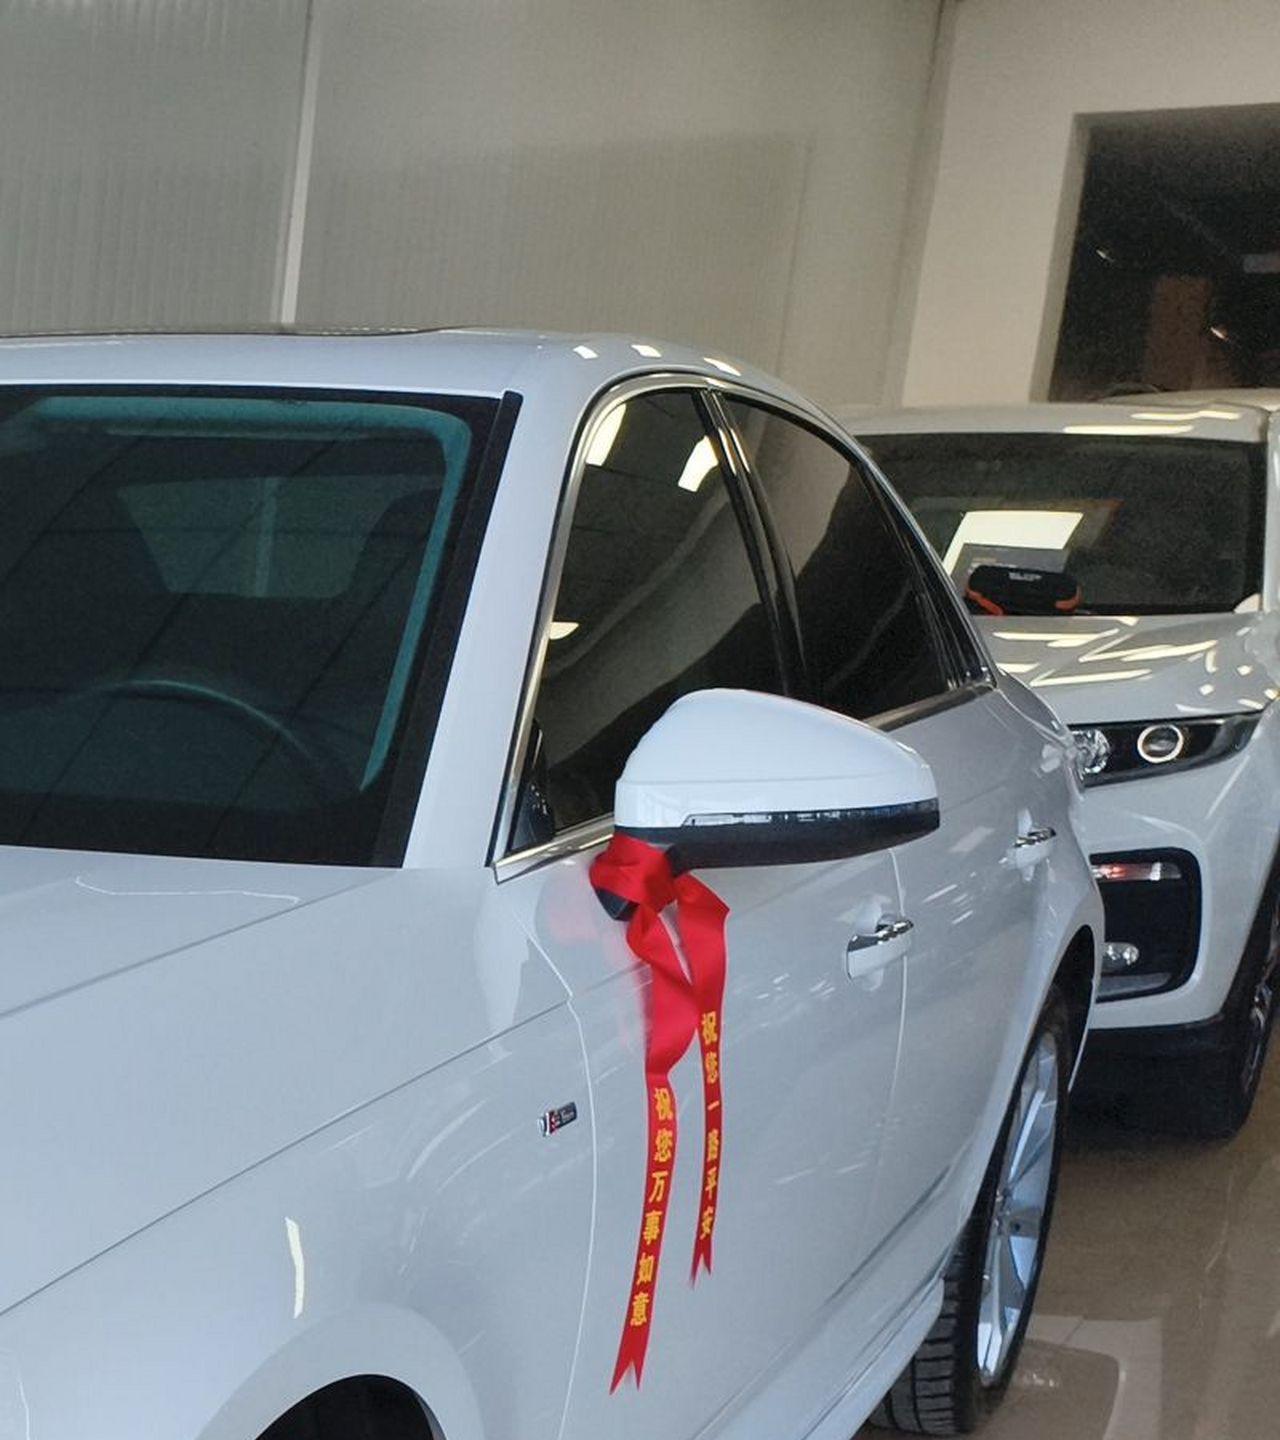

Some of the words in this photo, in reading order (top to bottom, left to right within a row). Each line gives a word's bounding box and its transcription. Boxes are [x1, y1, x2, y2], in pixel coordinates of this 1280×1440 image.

[630, 1087, 674, 1327] 祝您万事如意
[701, 1011, 720, 1240] 祝您一路平安
